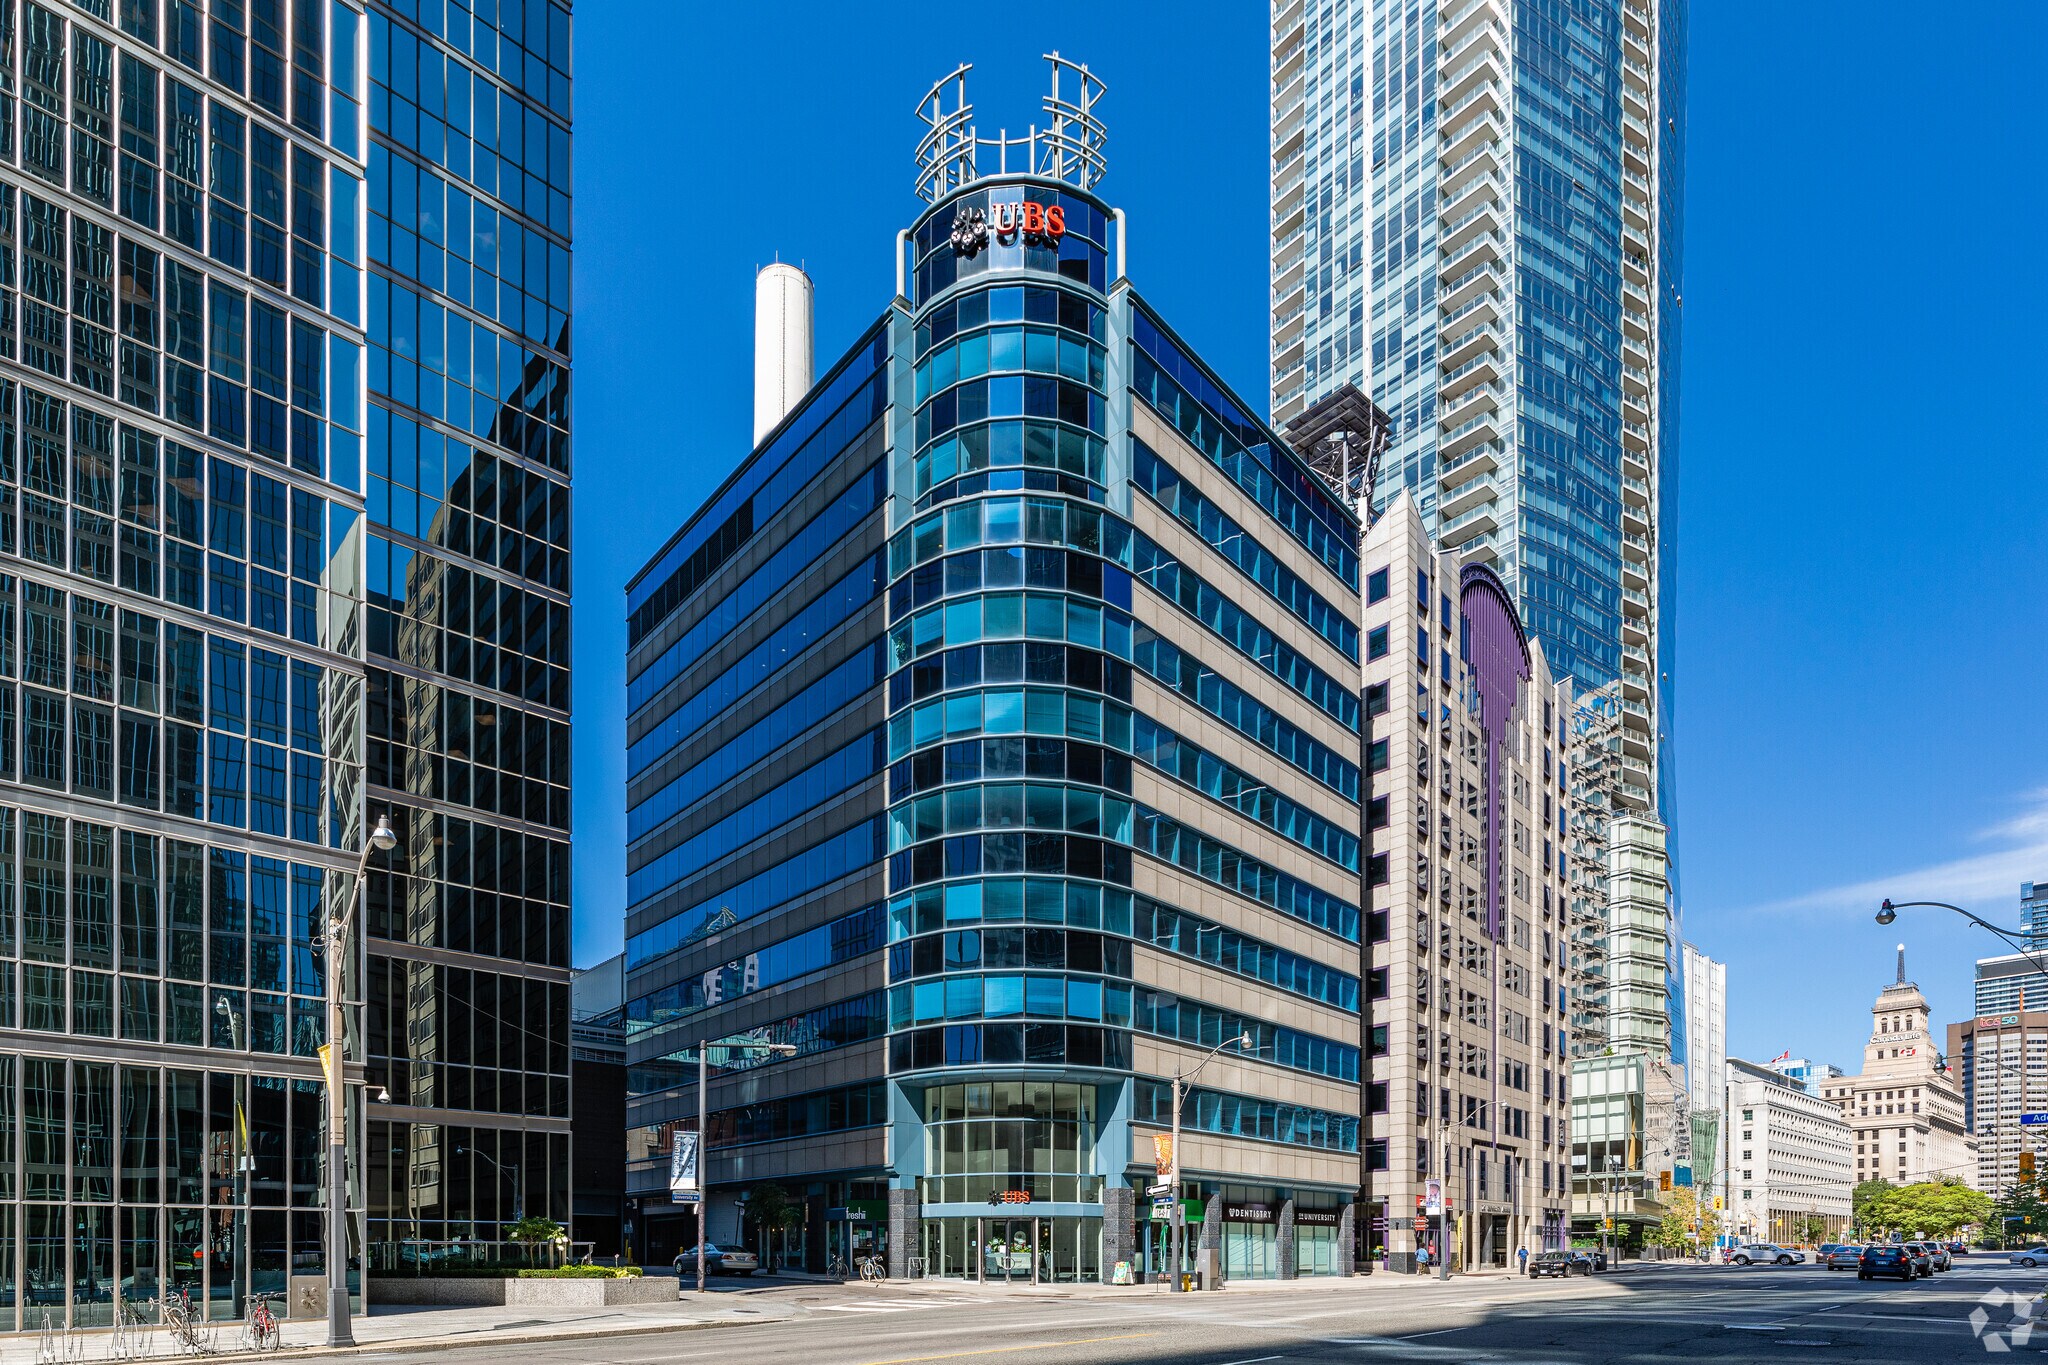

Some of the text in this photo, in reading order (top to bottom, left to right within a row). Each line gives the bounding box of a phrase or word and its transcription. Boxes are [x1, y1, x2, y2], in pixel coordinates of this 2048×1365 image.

[992, 201, 1066, 237] UBS
[1869, 1031, 1922, 1045] Canada Life
[1003, 1190, 1030, 1203] UBS
[1235, 1209, 1272, 1219] DENTISTRY
[1304, 1213, 1336, 1222] UNIVERSITY
